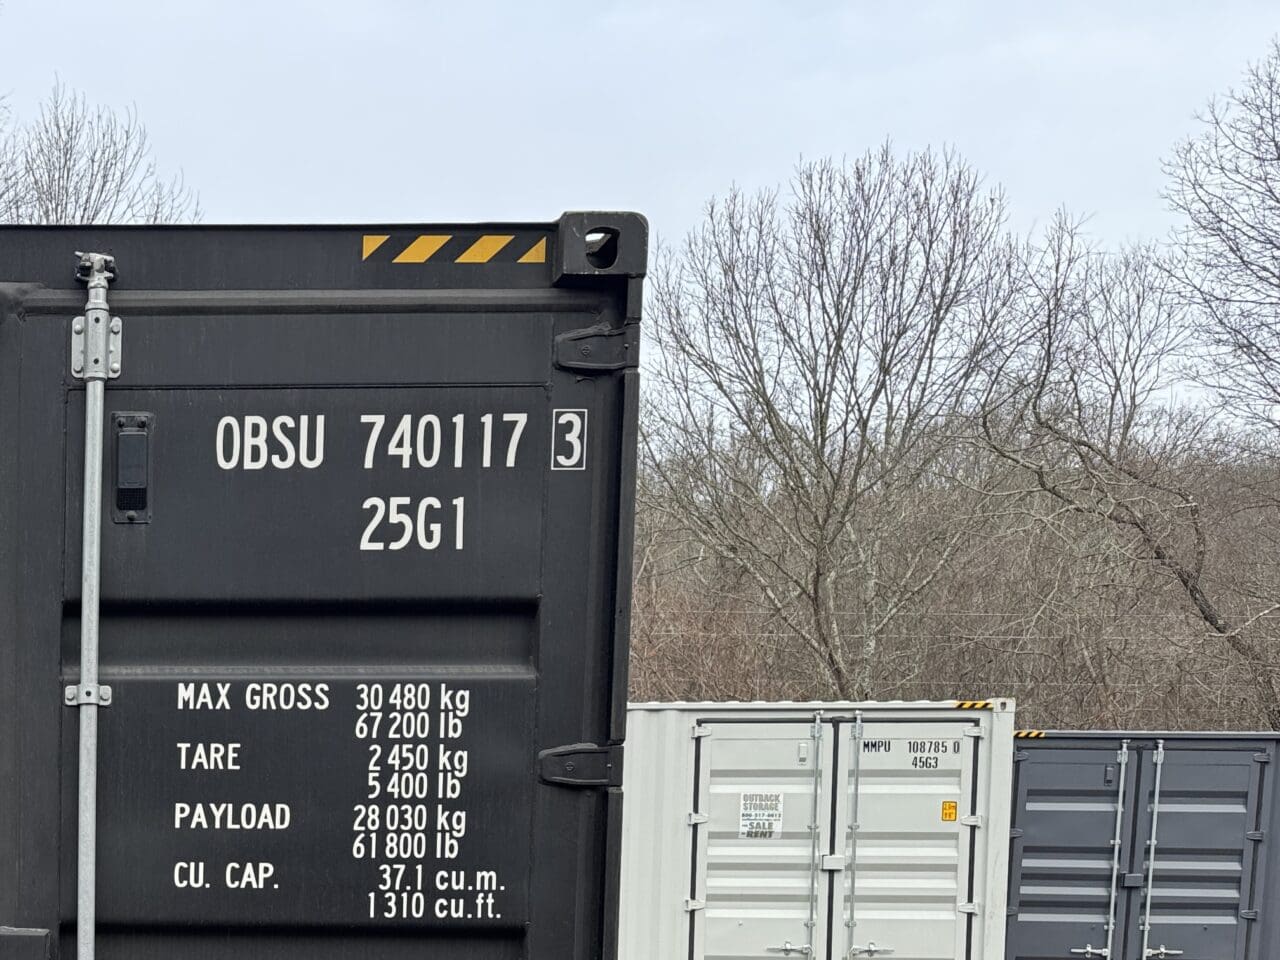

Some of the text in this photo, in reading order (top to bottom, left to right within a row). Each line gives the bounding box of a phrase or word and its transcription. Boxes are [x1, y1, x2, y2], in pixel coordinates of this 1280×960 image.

[216, 413, 583, 470] OBSU 740117 3
[359, 496, 464, 551] 25G1
[177, 682, 231, 710] MAX
[245, 683, 330, 710] GROSS
[439, 684, 470, 717] kg
[439, 711, 463, 739] lb
[177, 743, 241, 770] TARE
[438, 744, 468, 777] kg
[863, 740, 960, 754] MMPU 108785 0
[911, 756, 938, 768] 45G3
[438, 772, 461, 799] lb
[174, 803, 290, 830] PAYLOAD
[437, 804, 466, 837] kg
[743, 803, 779, 811] STORAGE
[746, 830, 775, 838] RENT
[749, 822, 773, 830] SALE
[435, 832, 459, 859] lb
[174, 862, 505, 891] CU. CAP. 37.1 cu.m.
[434, 893, 502, 919] cu.ft.
